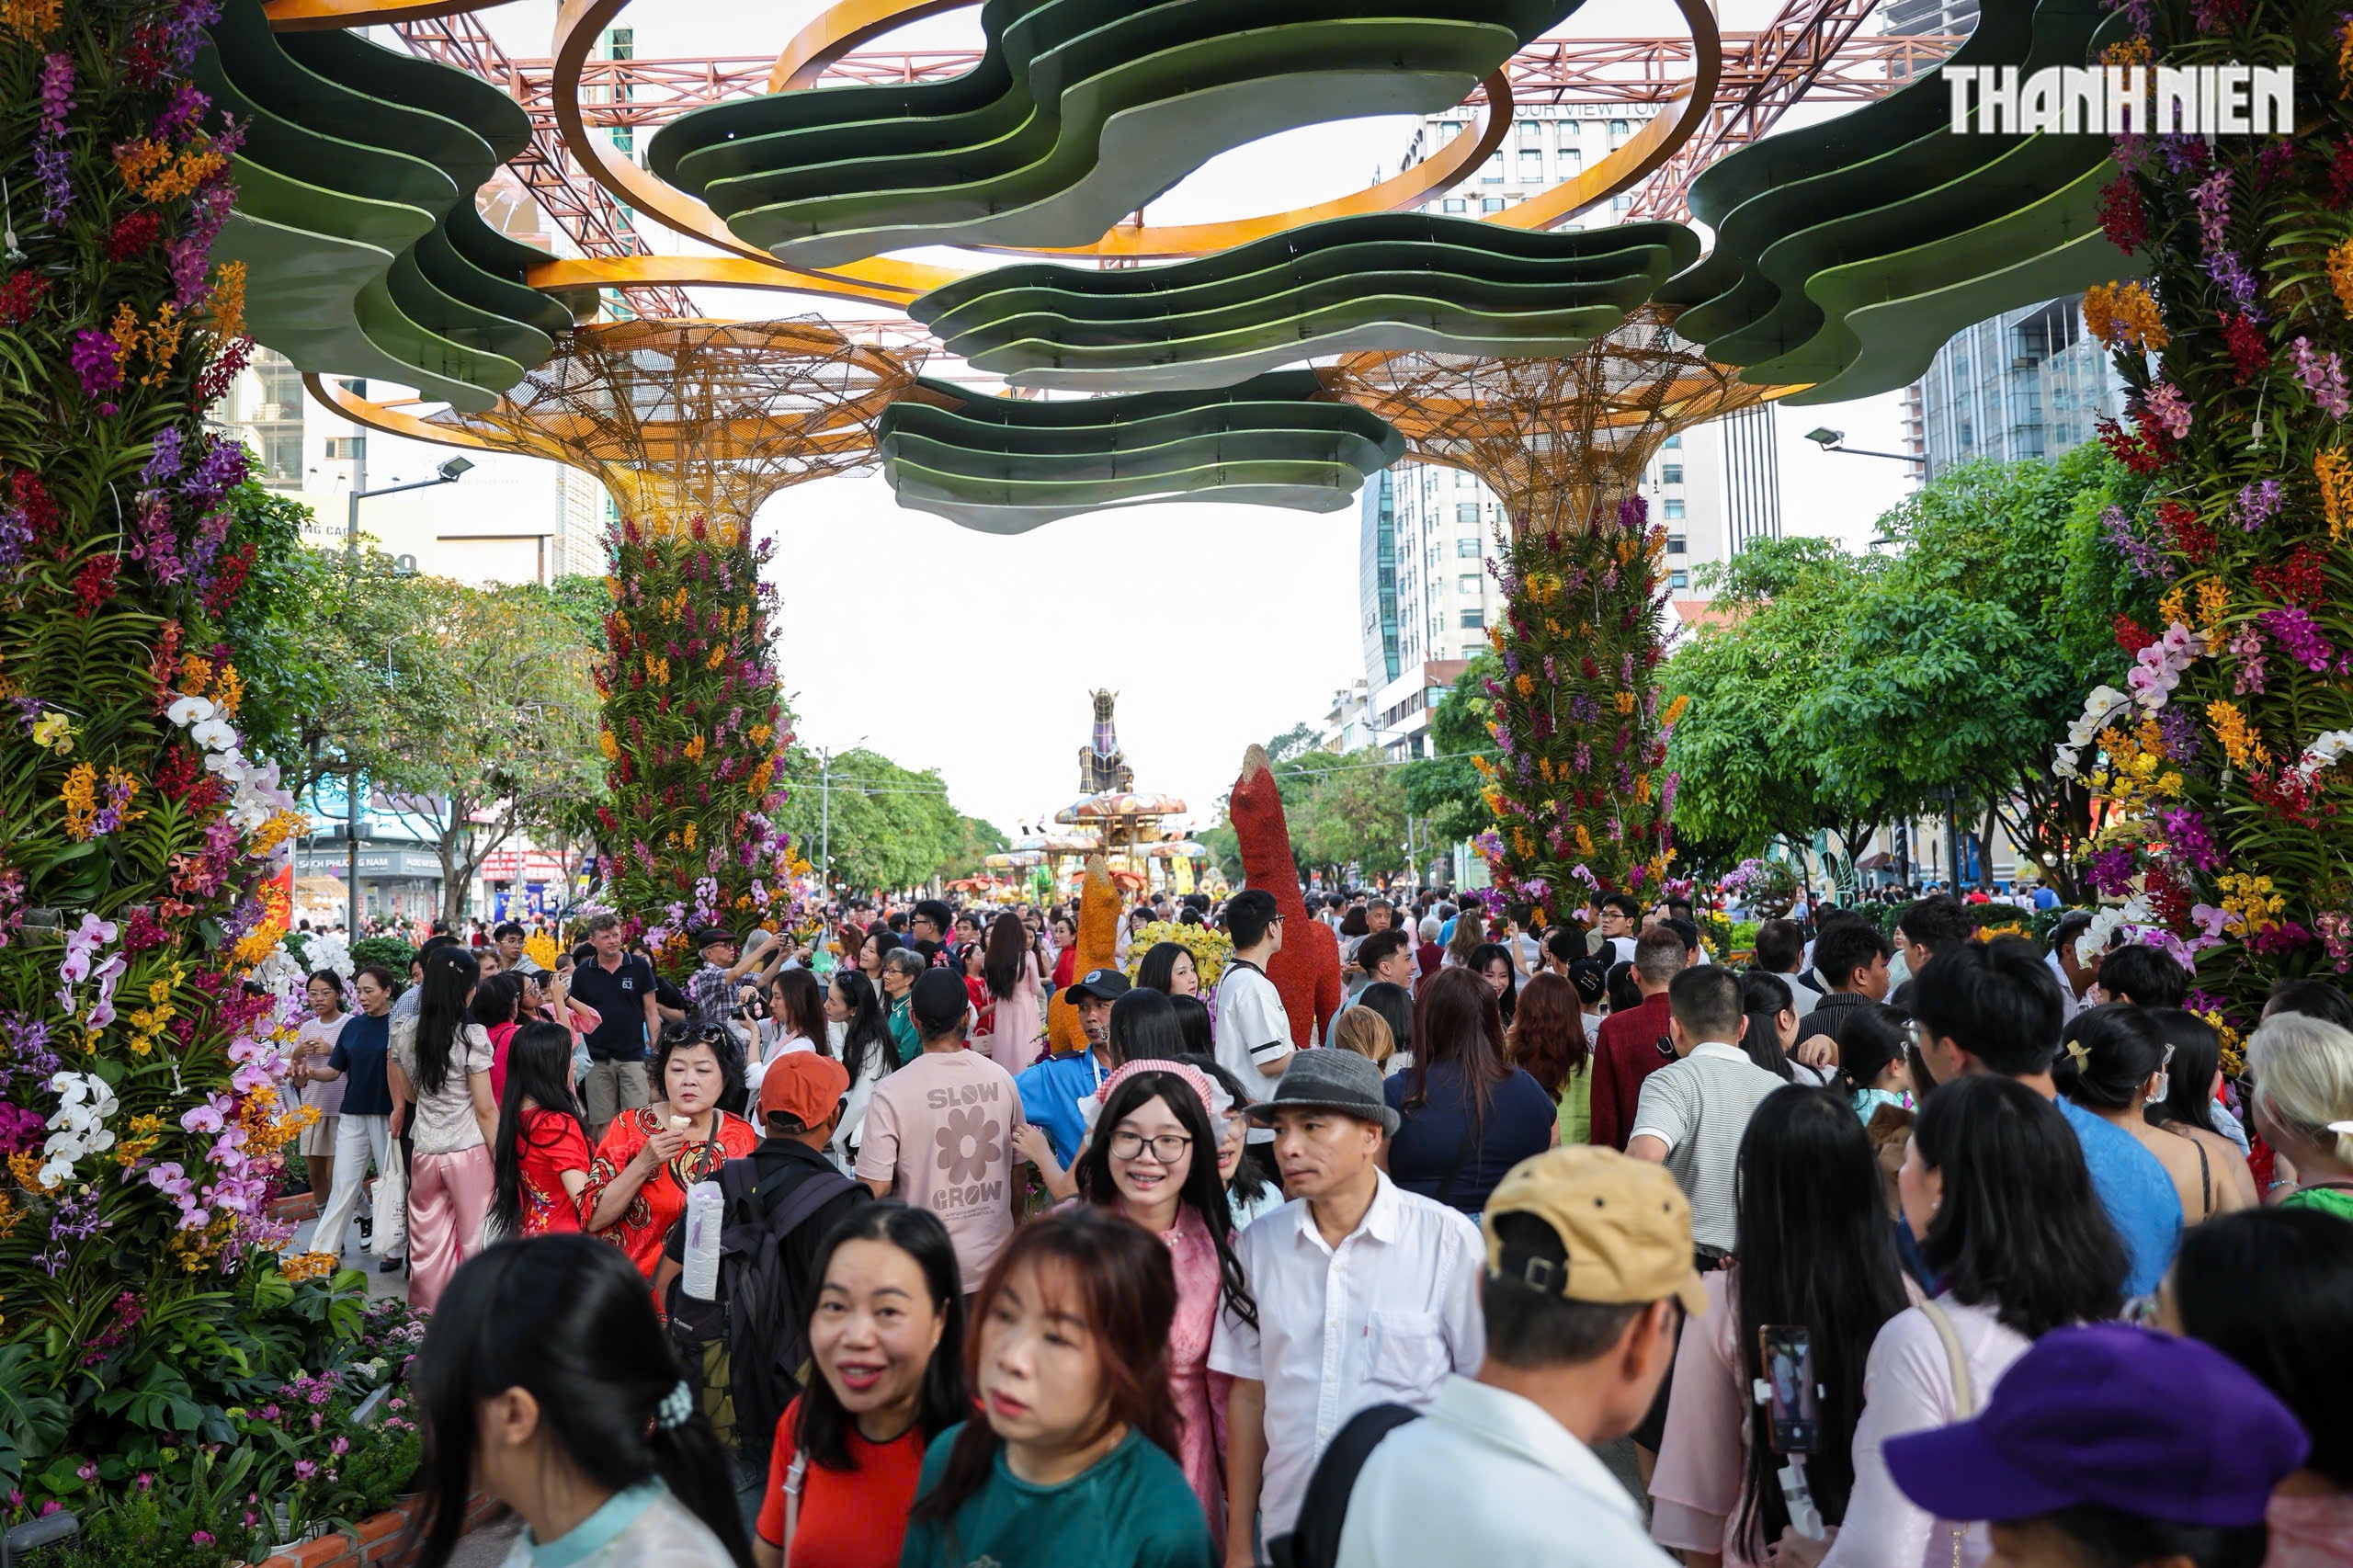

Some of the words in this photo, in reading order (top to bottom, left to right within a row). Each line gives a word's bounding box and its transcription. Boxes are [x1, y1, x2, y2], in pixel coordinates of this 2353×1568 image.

[1458, 103, 1557, 118] HAOUR
[1565, 103, 1613, 117] VIEW
[366, 858, 389, 867] NAM
[622, 980, 632, 990] 63
[926, 1082, 999, 1110] SLOW
[932, 1181, 1003, 1211] GROW
